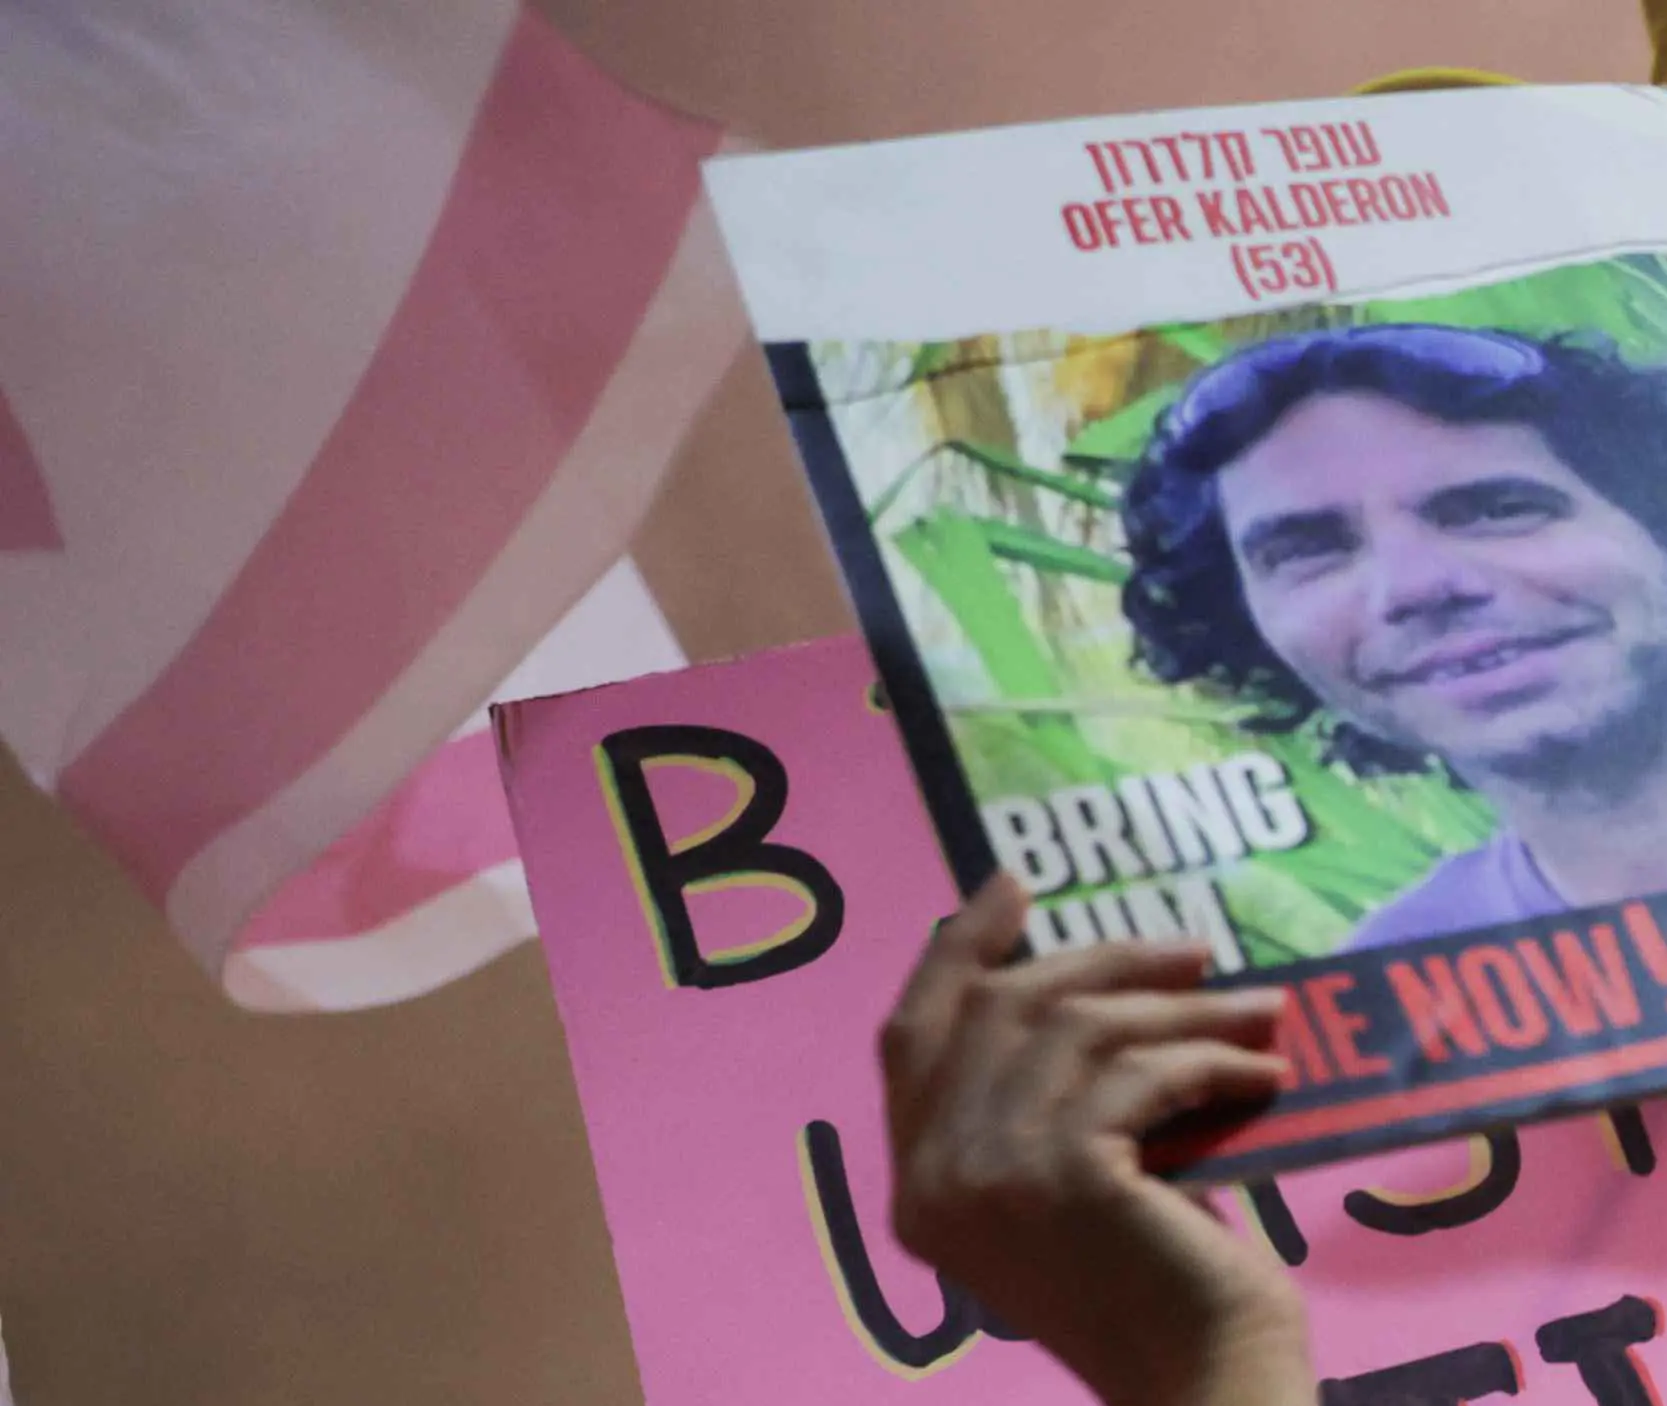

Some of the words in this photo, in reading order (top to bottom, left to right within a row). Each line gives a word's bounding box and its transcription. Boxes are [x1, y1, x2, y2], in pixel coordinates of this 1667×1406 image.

[1084, 131, 1256, 193] קלדרון
[1260, 120, 1381, 173] עופר
[1061, 196, 1191, 252] OFER
[1196, 171, 1451, 237] KALDERON
[1230, 236, 1337, 300] (53)
[982, 752, 1308, 896] BRING
[1274, 972, 1392, 1090] ME
